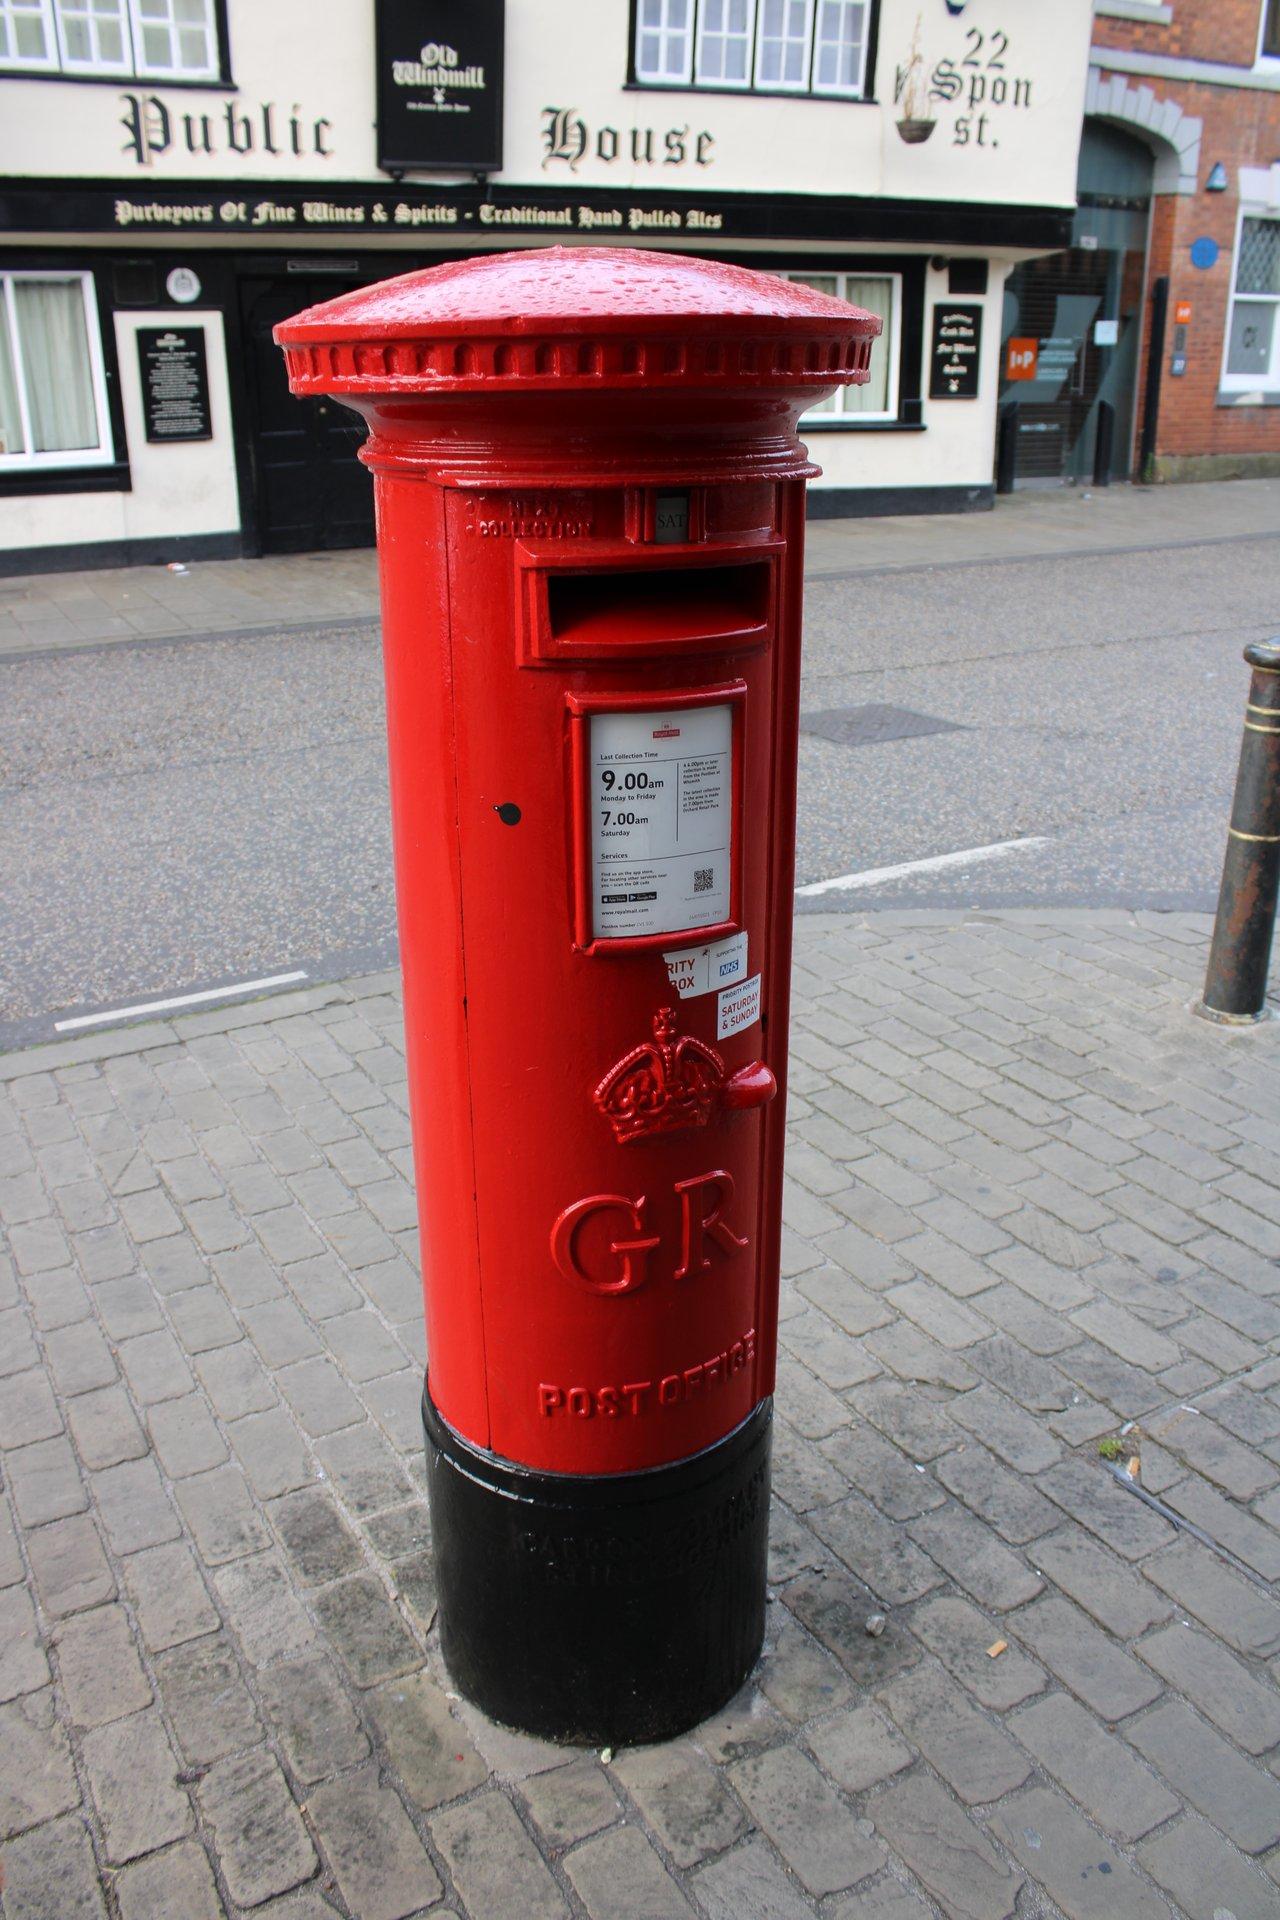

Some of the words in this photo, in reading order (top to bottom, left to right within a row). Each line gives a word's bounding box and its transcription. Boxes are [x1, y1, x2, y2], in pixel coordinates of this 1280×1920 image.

[421, 43, 458, 67] Old
[962, 27, 1008, 69] 22
[393, 60, 486, 88] Windmill
[929, 58, 1031, 109] Spon
[120, 93, 332, 166] Public
[541, 106, 715, 172] House
[115, 200, 213, 225] Purveyors
[220, 201, 247, 222] Of
[252, 201, 296, 225] Fine
[302, 202, 365, 223] Wines
[371, 203, 388, 223] &
[394, 203, 457, 226] Spirits
[479, 204, 573, 225] Traditional
[578, 206, 622, 229] Hand
[628, 208, 682, 230] Pulled
[686, 209, 722, 229] Ales
[657, 513, 688, 529] SAT
[601, 770, 664, 791] 9.00am
[637, 793, 656, 801] Friday
[601, 811, 649, 826] 7.00am
[601, 830, 630, 838] Saturday
[601, 908, 649, 916] www.royalmail.com
[720, 960, 739, 976] NHS
[721, 991, 759, 1017] SATURDAY
[722, 986, 743, 1000] PRIORITY
[722, 1020, 728, 1030] &
[730, 1003, 758, 1027] SUNDAY
[538, 1382, 651, 1418] POST
